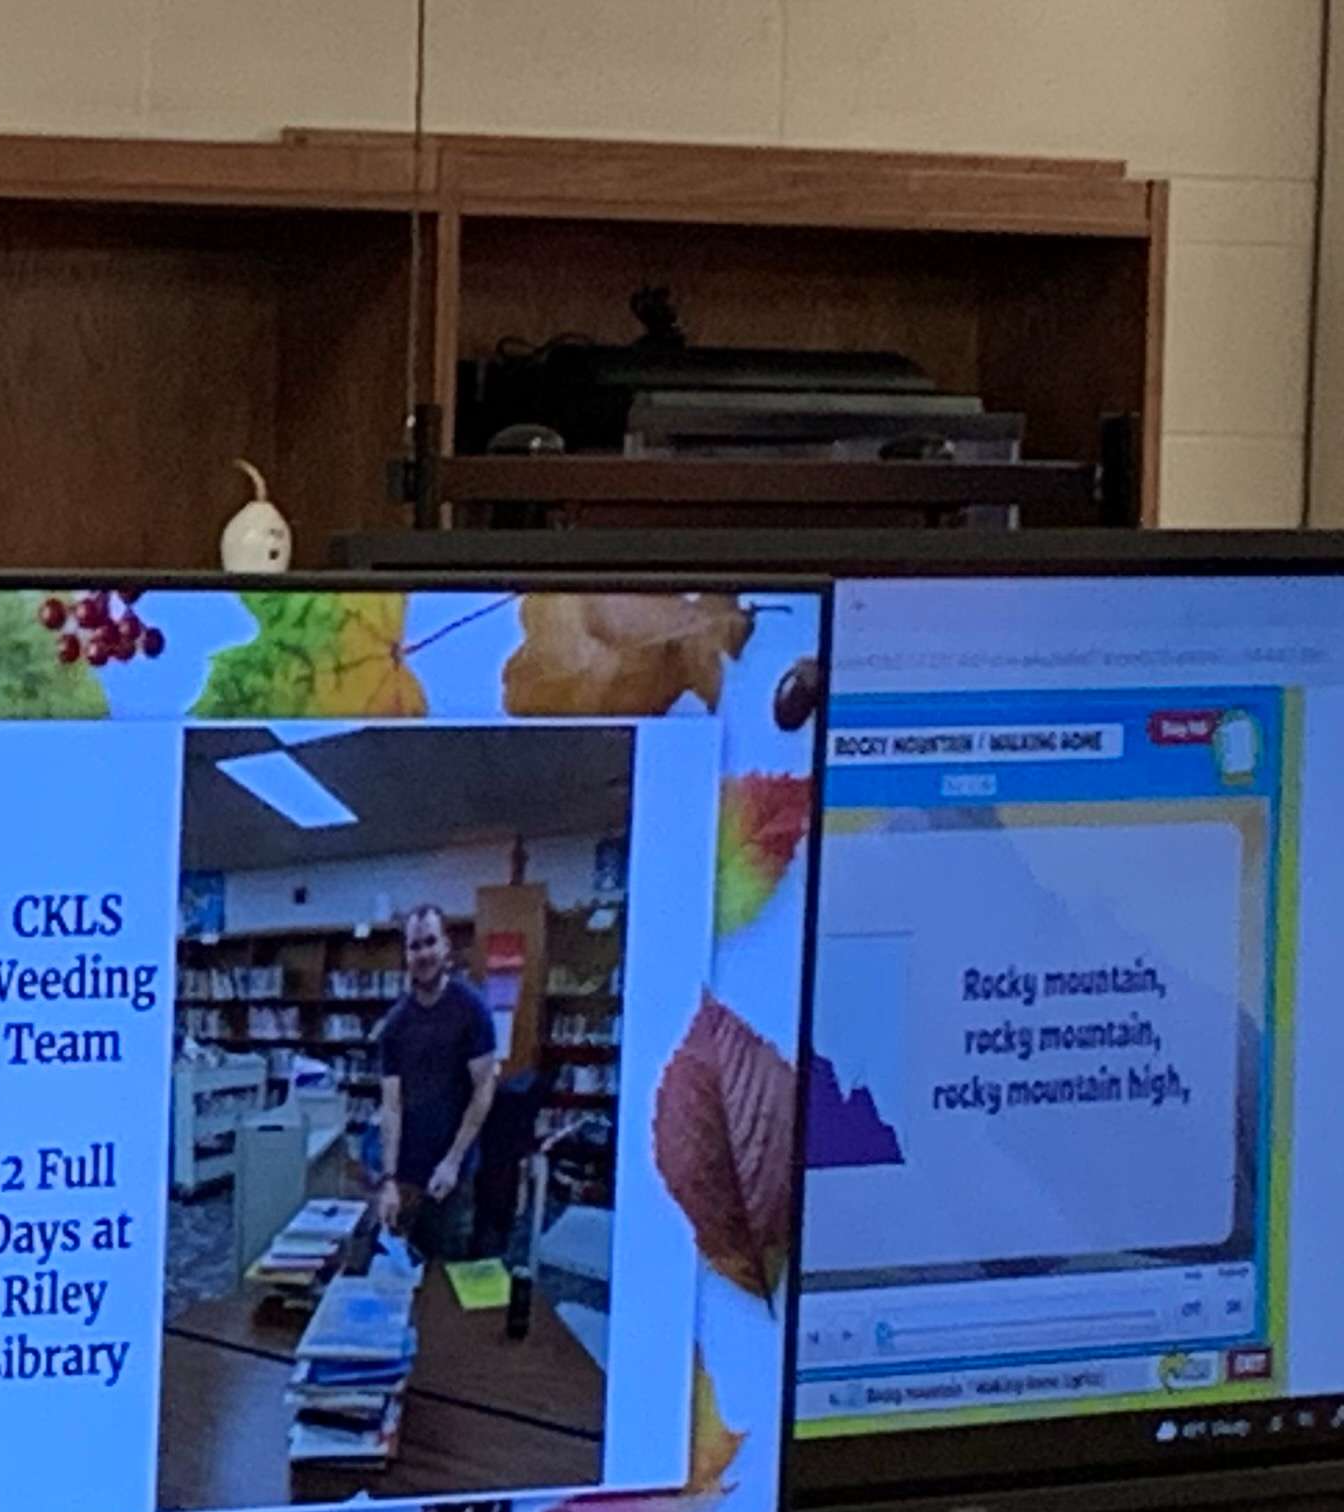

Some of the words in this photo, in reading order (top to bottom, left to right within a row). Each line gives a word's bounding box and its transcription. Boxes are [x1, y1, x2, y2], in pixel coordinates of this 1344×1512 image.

[11, 893, 124, 939] CKLS
[962, 963, 1039, 1006] Rocky
[1043, 956, 1168, 1000] mountain,
[2, 1021, 122, 1066] Team
[964, 1019, 1036, 1062] rocky
[1038, 1010, 1162, 1055] mountain,
[932, 1074, 1003, 1117] rocky
[1006, 1063, 1123, 1108] mountain
[1127, 1062, 1193, 1108] high,
[1, 1154, 24, 1193] 2
[36, 1141, 117, 1192] Full
[91, 1208, 135, 1250] at
[1, 1268, 109, 1326] Riley
